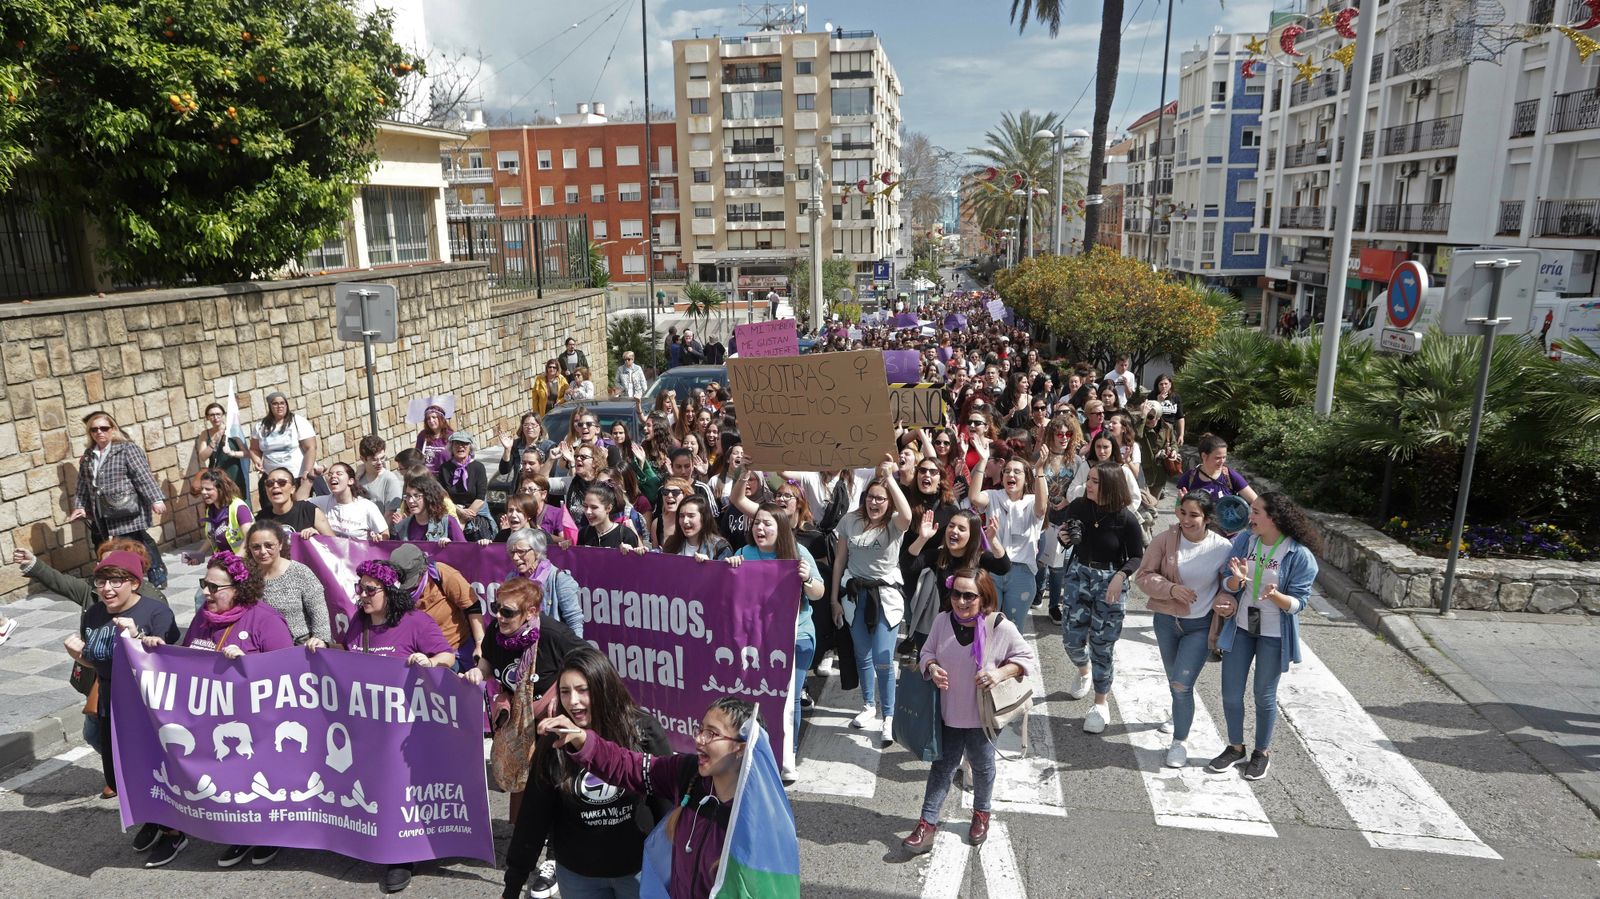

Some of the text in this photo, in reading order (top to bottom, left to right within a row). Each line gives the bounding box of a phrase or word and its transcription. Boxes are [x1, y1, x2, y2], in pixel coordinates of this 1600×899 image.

[737, 328, 745, 338] A
[742, 340, 753, 350] ME
[733, 361, 836, 393] NOSOTRAS
[742, 394, 872, 416] DECIDIMOS Y
[913, 390, 943, 426] NO
[849, 424, 878, 443] OS
[578, 586, 713, 645] paramos,
[607, 642, 685, 690] para!
[187, 675, 234, 716] UN
[250, 672, 338, 714] PASO
[348, 678, 459, 729] ATRÁS!
[405, 782, 465, 802] MAREA
[268, 808, 378, 837] #FeminismoAndalú
[398, 827, 425, 838] CAMPO
[426, 826, 435, 835] DE
